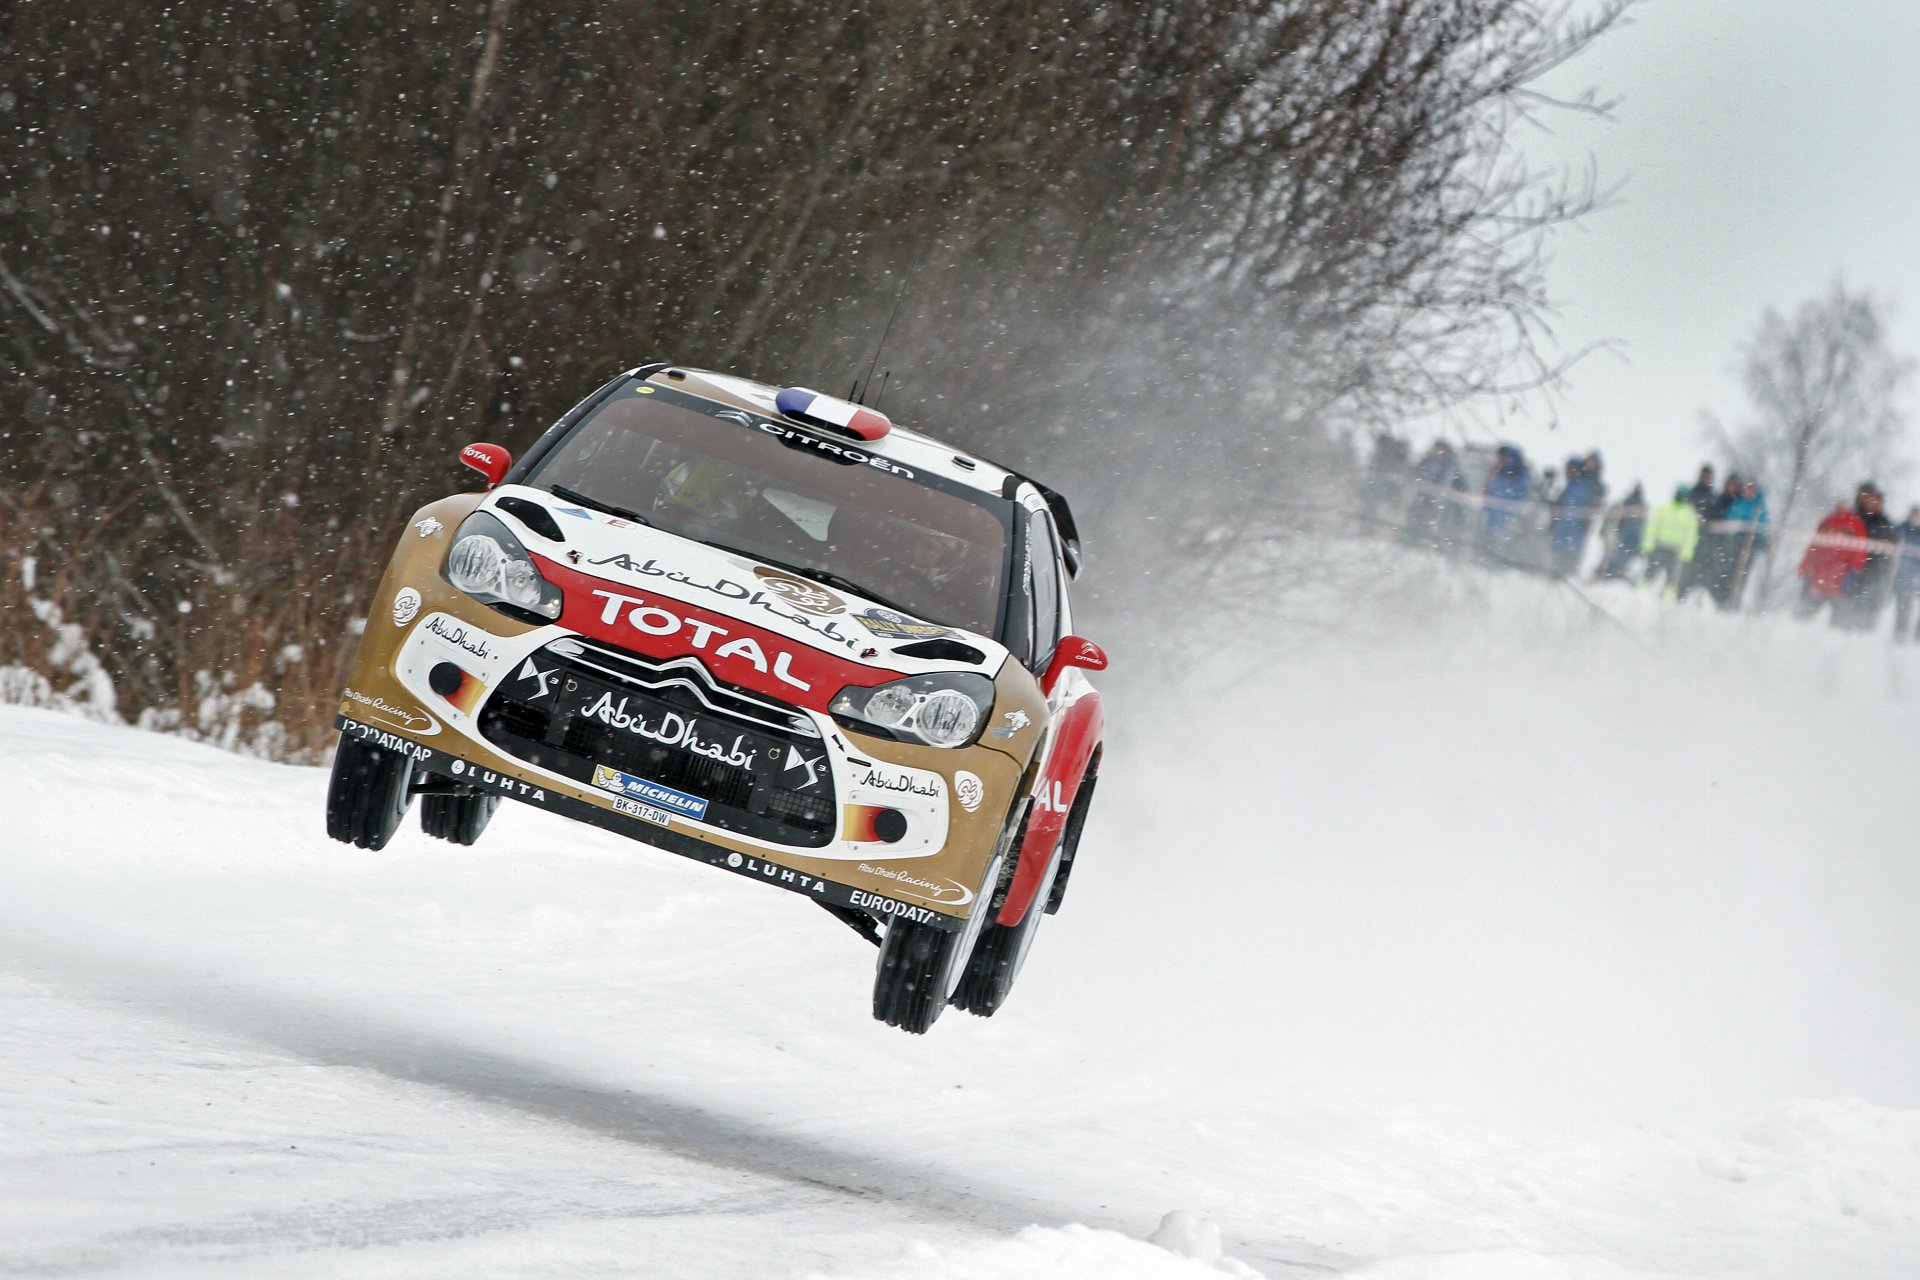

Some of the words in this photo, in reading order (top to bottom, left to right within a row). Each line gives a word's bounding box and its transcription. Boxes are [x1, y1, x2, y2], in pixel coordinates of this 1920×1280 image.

[463, 447, 493, 465] TOTAL
[591, 588, 812, 693] TOTAL
[467, 766, 545, 802] LUHTA
[626, 781, 705, 812] MICHELIN
[615, 798, 669, 824] BK-317-DW
[746, 859, 826, 893] LUHTA
[858, 862, 876, 874] Abu
[874, 866, 898, 880] Dhabi
[896, 870, 961, 898] Racing
